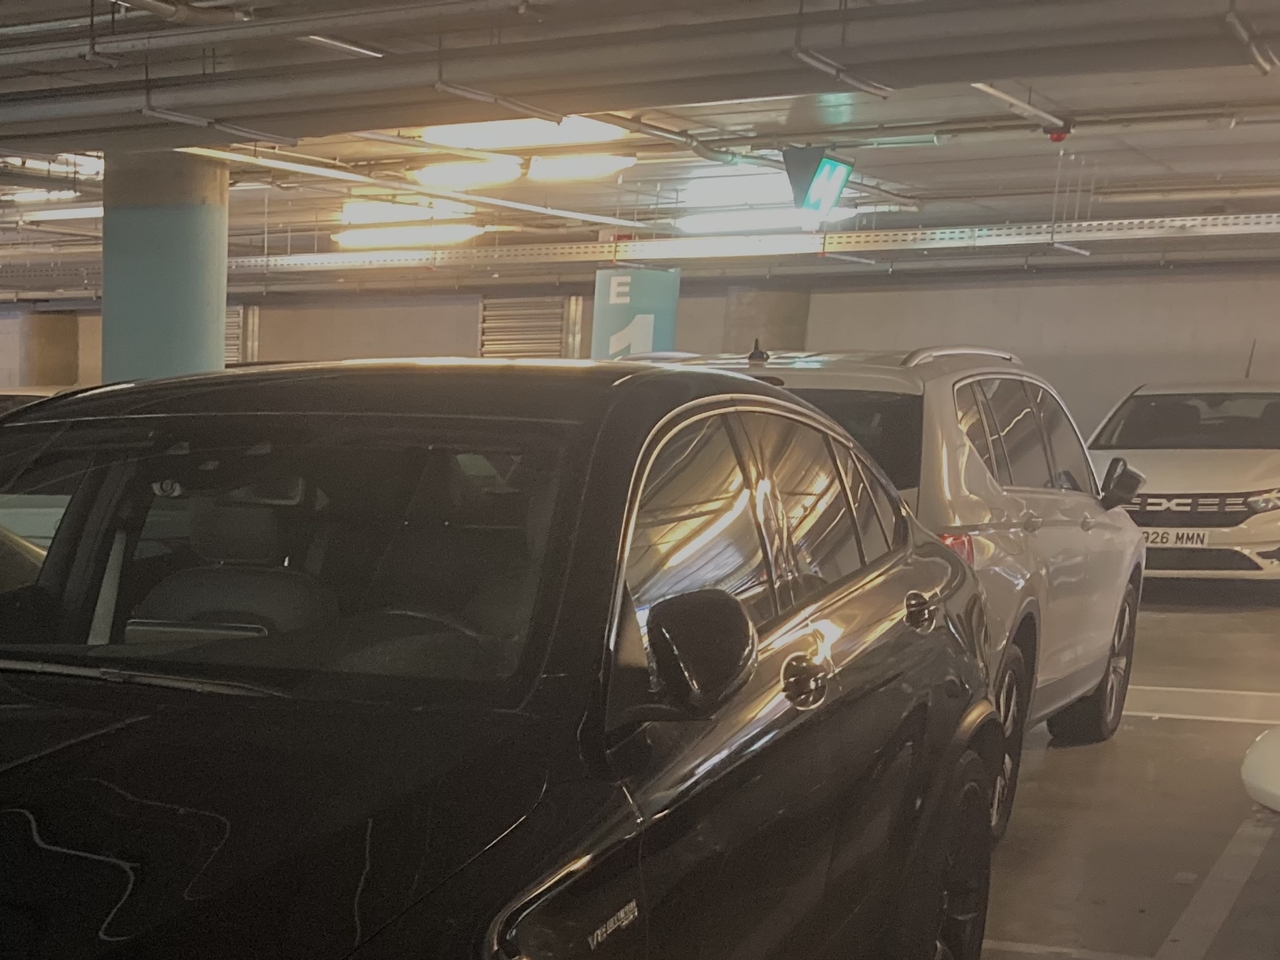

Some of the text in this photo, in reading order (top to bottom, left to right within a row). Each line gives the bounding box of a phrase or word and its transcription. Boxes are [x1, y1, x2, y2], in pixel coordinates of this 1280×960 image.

[609, 276, 631, 304] E
[608, 314, 655, 355] 1
[1174, 532, 1206, 545] MMN
